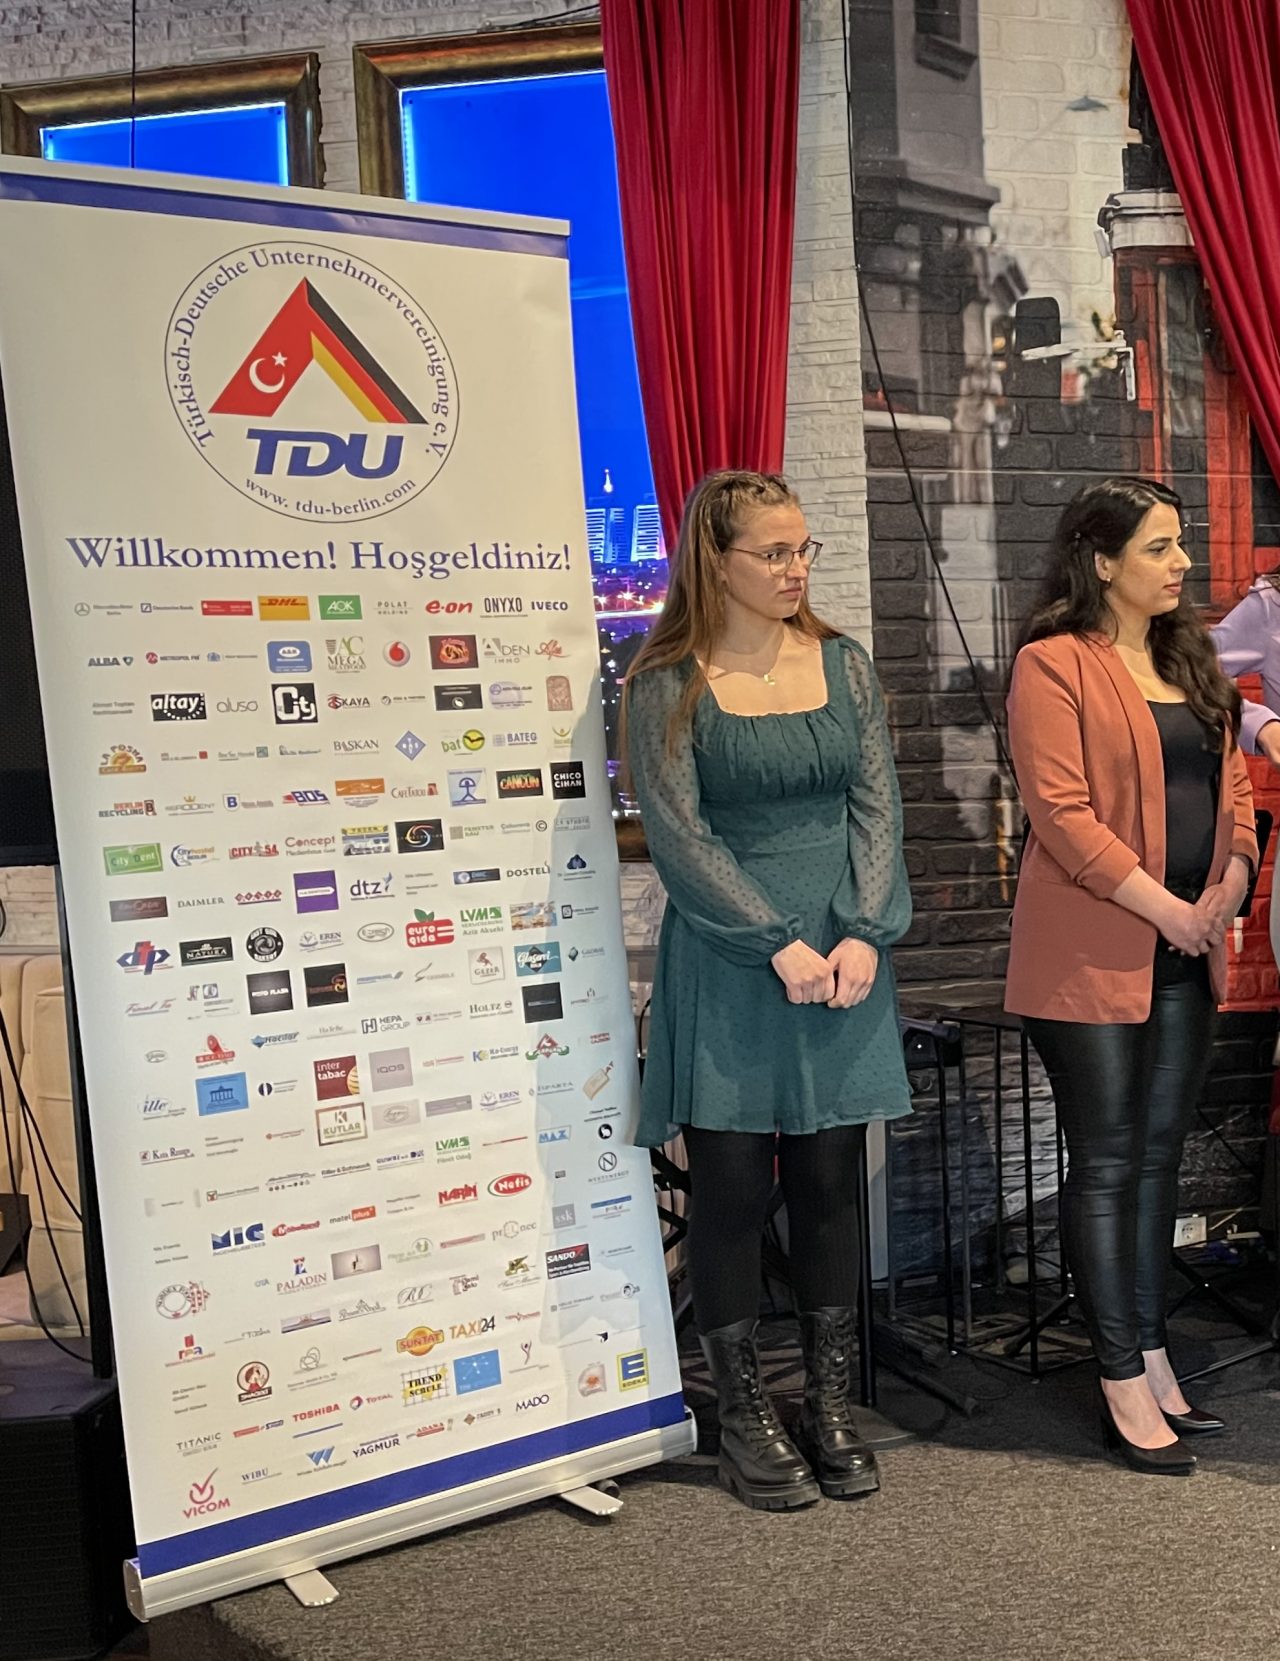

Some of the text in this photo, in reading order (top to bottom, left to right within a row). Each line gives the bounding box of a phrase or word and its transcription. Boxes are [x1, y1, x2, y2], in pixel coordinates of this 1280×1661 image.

[170, 259, 248, 447] Türkisch-Deutsche
[248, 248, 451, 419] Unternehmervereinigung
[246, 428, 404, 479] TDU
[67, 536, 571, 578] Willkommen! Hoşgeldiniz!
[267, 598, 298, 606] DHL
[328, 601, 353, 612] AOK
[484, 597, 523, 613] ONYXO
[531, 601, 568, 611] IVECO
[88, 657, 120, 667] ALBA
[152, 694, 199, 713] altay
[217, 698, 258, 713] aluso
[441, 739, 461, 752] bat
[554, 772, 582, 780] CHICO
[554, 779, 582, 787] CIHAN
[285, 836, 336, 847] Concept
[231, 847, 253, 857] CITY
[350, 880, 383, 897] dtz
[178, 897, 224, 908] DAIMLER
[460, 908, 488, 922] LVM
[407, 925, 435, 937] euro
[317, 1061, 340, 1071] inter
[377, 1063, 405, 1074] IQOS
[317, 1070, 346, 1080] tabac
[323, 1123, 361, 1136] KUTLAR
[499, 1175, 530, 1193] Nefis
[547, 1250, 576, 1263] SANDO
[277, 1273, 327, 1292] PALADIN
[400, 1333, 441, 1348] SUNTAT
[407, 1374, 442, 1387] TREND
[515, 1394, 550, 1412] MADO
[293, 1404, 340, 1422] TOSHIBA
[177, 1432, 221, 1450] TITANIC
[184, 1497, 230, 1518] VICOM
